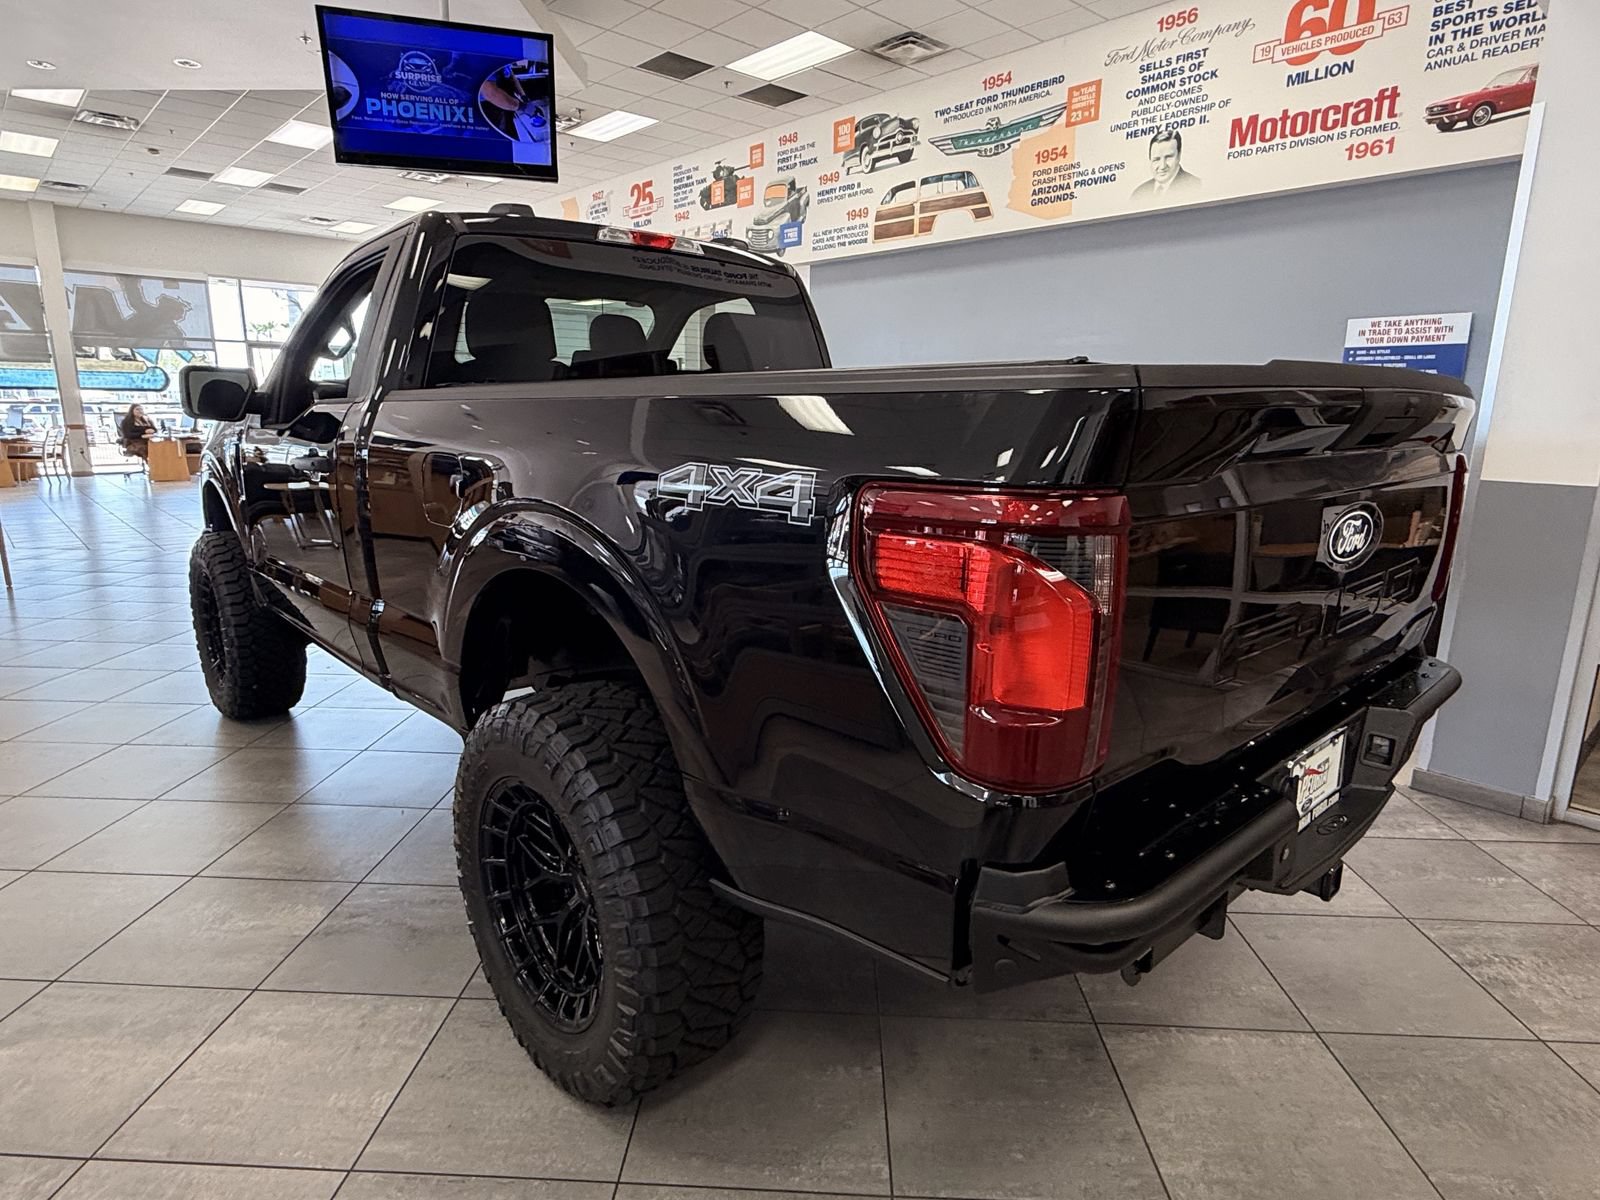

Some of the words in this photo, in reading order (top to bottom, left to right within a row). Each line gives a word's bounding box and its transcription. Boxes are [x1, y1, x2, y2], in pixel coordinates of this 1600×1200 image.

[1433, 0, 1473, 17] BEST
[1158, 8, 1199, 32] 1956
[1430, 6, 1498, 32] SPORTS
[1104, 46, 1140, 67] Ford
[1130, 38, 1178, 64] Motor
[1178, 18, 1255, 46] Company
[1260, 46, 1270, 57] 19
[1281, 39, 1322, 56] VEHICLES
[1324, 25, 1374, 46] PRODUCED
[1387, 12, 1402, 26] 63
[1285, 0, 1376, 65] 60
[1428, 33, 1446, 46] IN
[1451, 24, 1484, 40] THE
[1426, 45, 1453, 58] CAR
[1456, 42, 1465, 52] &
[1470, 30, 1520, 49] DRIVER
[1139, 56, 1172, 74] SELLS
[1175, 48, 1210, 66] FIRST
[1424, 52, 1478, 72] ANNUAL
[395, 72, 442, 84] SURPRISE
[982, 71, 1012, 91] 1954
[1140, 66, 1185, 84] SHARES
[1188, 61, 1205, 72] OF
[1286, 60, 1354, 88] MILLION
[1081, 84, 1096, 94] YEAR
[1126, 80, 1176, 100] COMMON
[1179, 68, 1218, 86] STOCK
[400, 94, 432, 103] SERVING
[934, 100, 973, 119] TWO-SEAT
[976, 94, 998, 107] FORD
[1002, 74, 1065, 99] THUNDERBIRD
[1138, 94, 1156, 106] AND
[1158, 85, 1203, 102] BECOMES
[366, 98, 474, 123] PHOENIX!
[943, 106, 983, 124] INTRODUCED
[985, 106, 992, 114] IN
[993, 98, 1016, 112] NORTH
[1018, 90, 1052, 106] AMERICA.
[1110, 120, 1138, 133] UNDER
[1140, 116, 1158, 126] THE
[1160, 102, 1216, 122] LEADERSHIP
[1218, 98, 1232, 109] OF
[1131, 94, 1208, 118] PUBLICLY-OWNED
[1228, 86, 1400, 148] Motorcraft
[1126, 124, 1161, 140] HENRY
[1165, 116, 1196, 133] FORD
[778, 132, 798, 146] 1948
[1227, 148, 1253, 160] FORD
[1255, 142, 1287, 156] PARTS
[1289, 134, 1334, 149] DIVISION
[1337, 131, 1347, 140] IS
[1349, 121, 1400, 138] FORMED.
[1344, 136, 1396, 160] 1961
[778, 148, 789, 157] FORD
[790, 145, 806, 154] BUILDS
[807, 142, 816, 150] THE
[778, 154, 792, 164] FIRST
[1034, 145, 1068, 165] 1954
[778, 162, 798, 173] PICKUP
[799, 157, 818, 169] TRUCK
[1032, 166, 1052, 178] FORD
[1054, 161, 1081, 174] BEGINS
[1032, 174, 1055, 186] CRASH
[1057, 169, 1090, 182] TESTING
[1098, 162, 1126, 174] OPENS
[818, 171, 840, 186] 1949
[1030, 183, 1071, 198] ARIZONA
[1074, 174, 1117, 189] PROVING
[630, 180, 654, 219] 25
[817, 188, 838, 197] HENRY
[838, 183, 855, 192] FORD
[817, 196, 833, 205] DRIVES
[848, 190, 858, 198] WAR
[1030, 191, 1078, 207] GROUNDS.
[633, 219, 652, 228] MILLION
[674, 210, 690, 222] 1942
[846, 207, 869, 221] 1949
[833, 226, 846, 234] POST
[836, 230, 868, 240] INTRODUCED
[812, 242, 836, 251] INCLUDING
[1368, 328, 1392, 336] TRADE
[1405, 326, 1432, 335] ASSIST
[1371, 320, 1381, 328] WE
[1384, 320, 1402, 328] TAKE
[1404, 318, 1442, 326] ANYTHING
[1387, 336, 1409, 344] DOWN
[1410, 334, 1446, 343] PAYMENT
[1338, 519, 1368, 554] Ford
[906, 626, 962, 642] FORD
